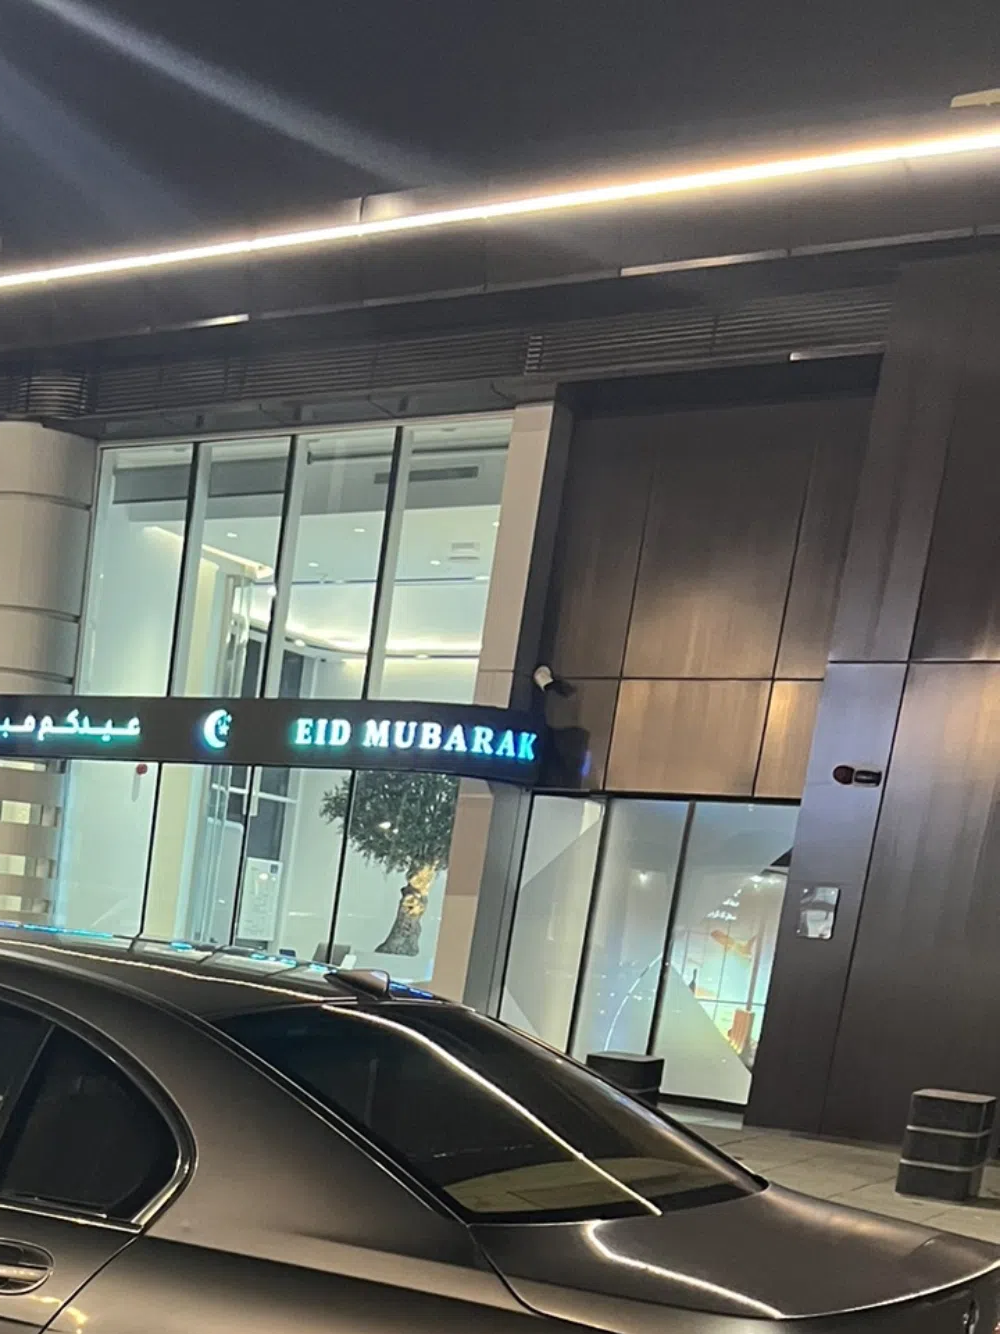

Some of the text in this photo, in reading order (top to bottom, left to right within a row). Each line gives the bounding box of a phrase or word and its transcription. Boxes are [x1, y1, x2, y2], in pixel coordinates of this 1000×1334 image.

[37, 708, 141, 742] عيدكم
[295, 718, 537, 760] EID MUBARAK
